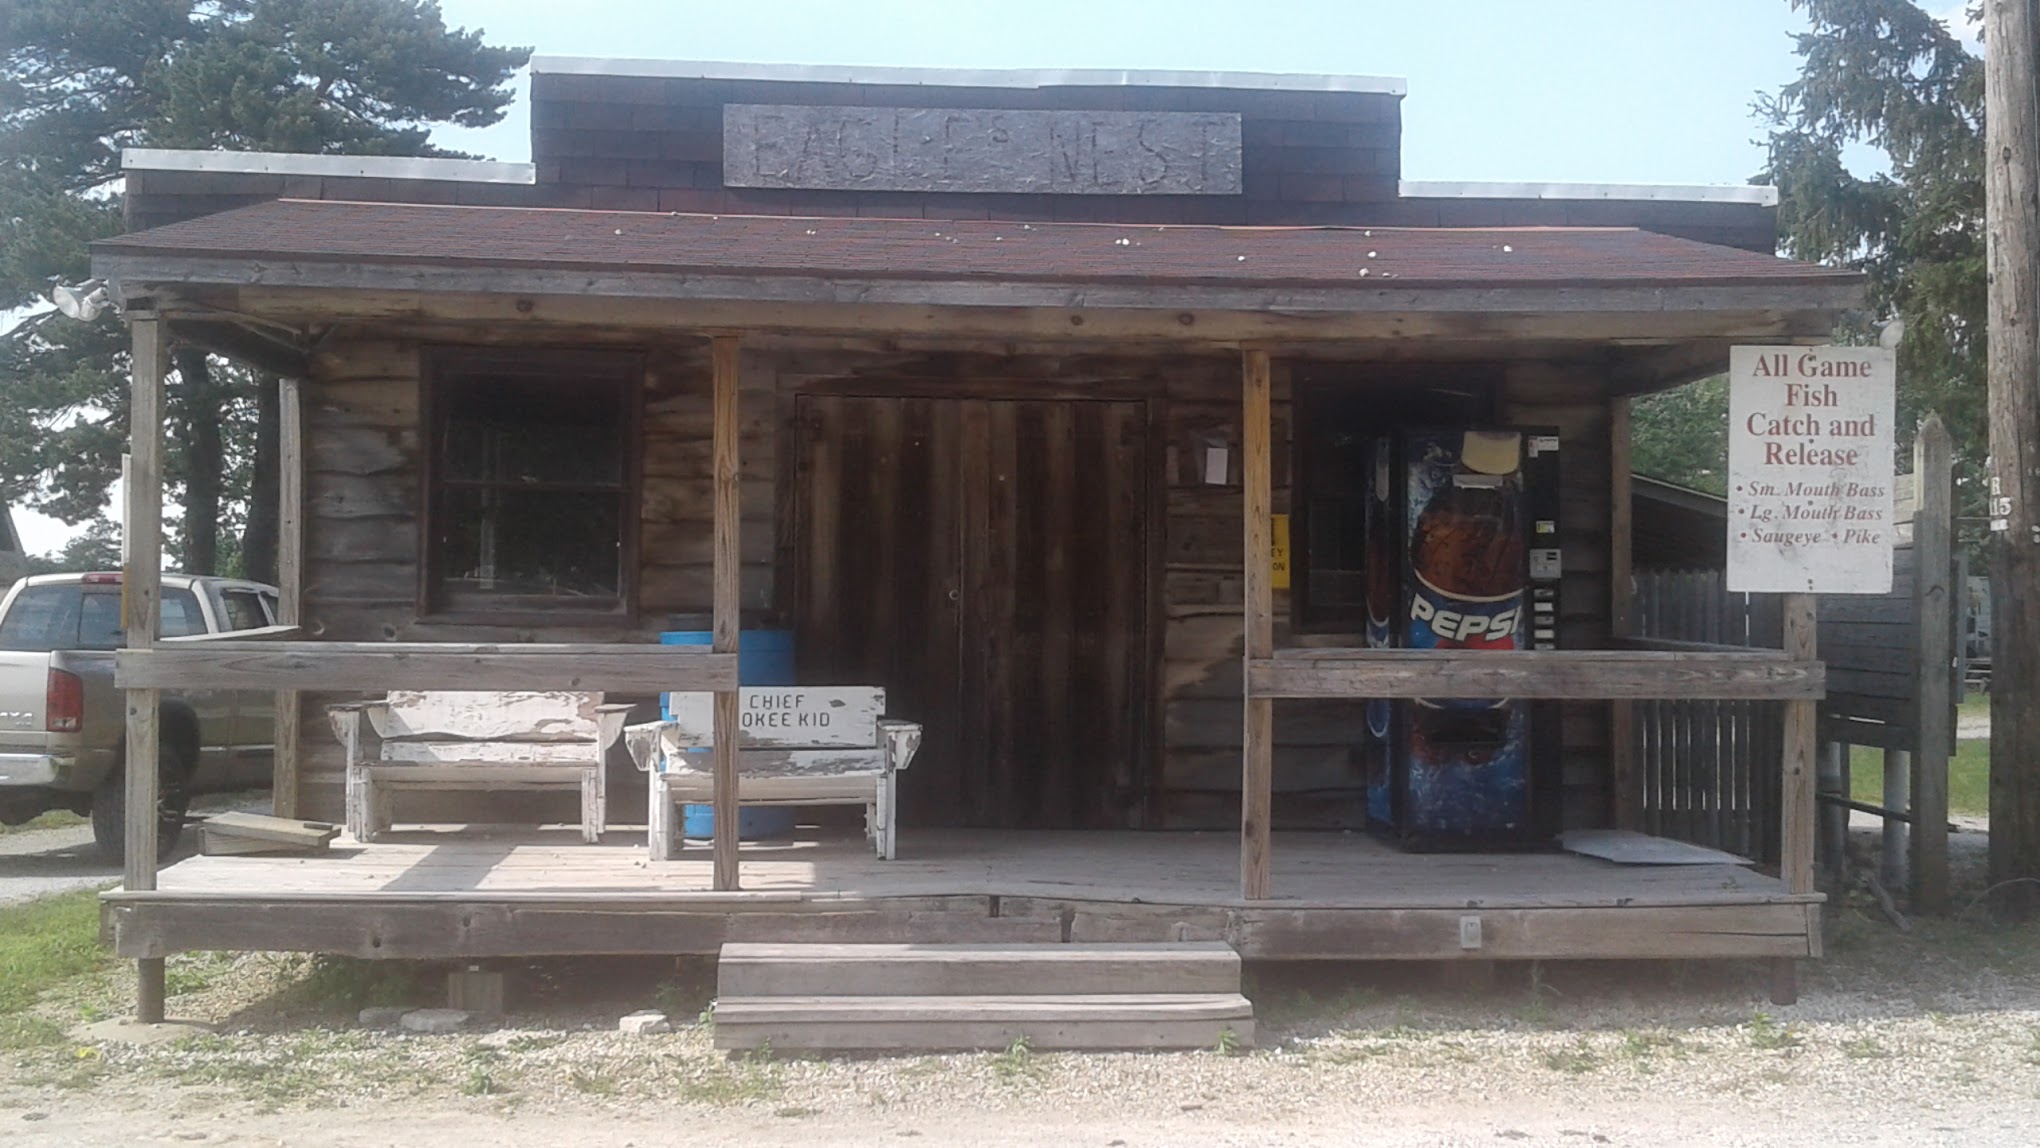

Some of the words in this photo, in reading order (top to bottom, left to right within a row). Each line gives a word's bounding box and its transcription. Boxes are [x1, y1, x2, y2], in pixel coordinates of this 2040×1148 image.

[1752, 354, 1789, 377] All
[1797, 353, 1872, 378] Game
[1784, 384, 1838, 407] Fish
[1747, 412, 1820, 436] Catch
[1829, 414, 1875, 437] and
[1764, 442, 1858, 466] Release
[1785, 482, 1839, 497] Mouth
[1846, 482, 1885, 497] Bass
[1750, 504, 1778, 523] Lg.
[1782, 505, 1838, 520] Mouth
[1844, 505, 1883, 520] Bass
[1752, 528, 1821, 547] Saugeye
[1843, 529, 1881, 544] Pike
[1410, 592, 1522, 642] PEPSI
[750, 694, 805, 709] CHIEF
[742, 712, 791, 727] OKEE
